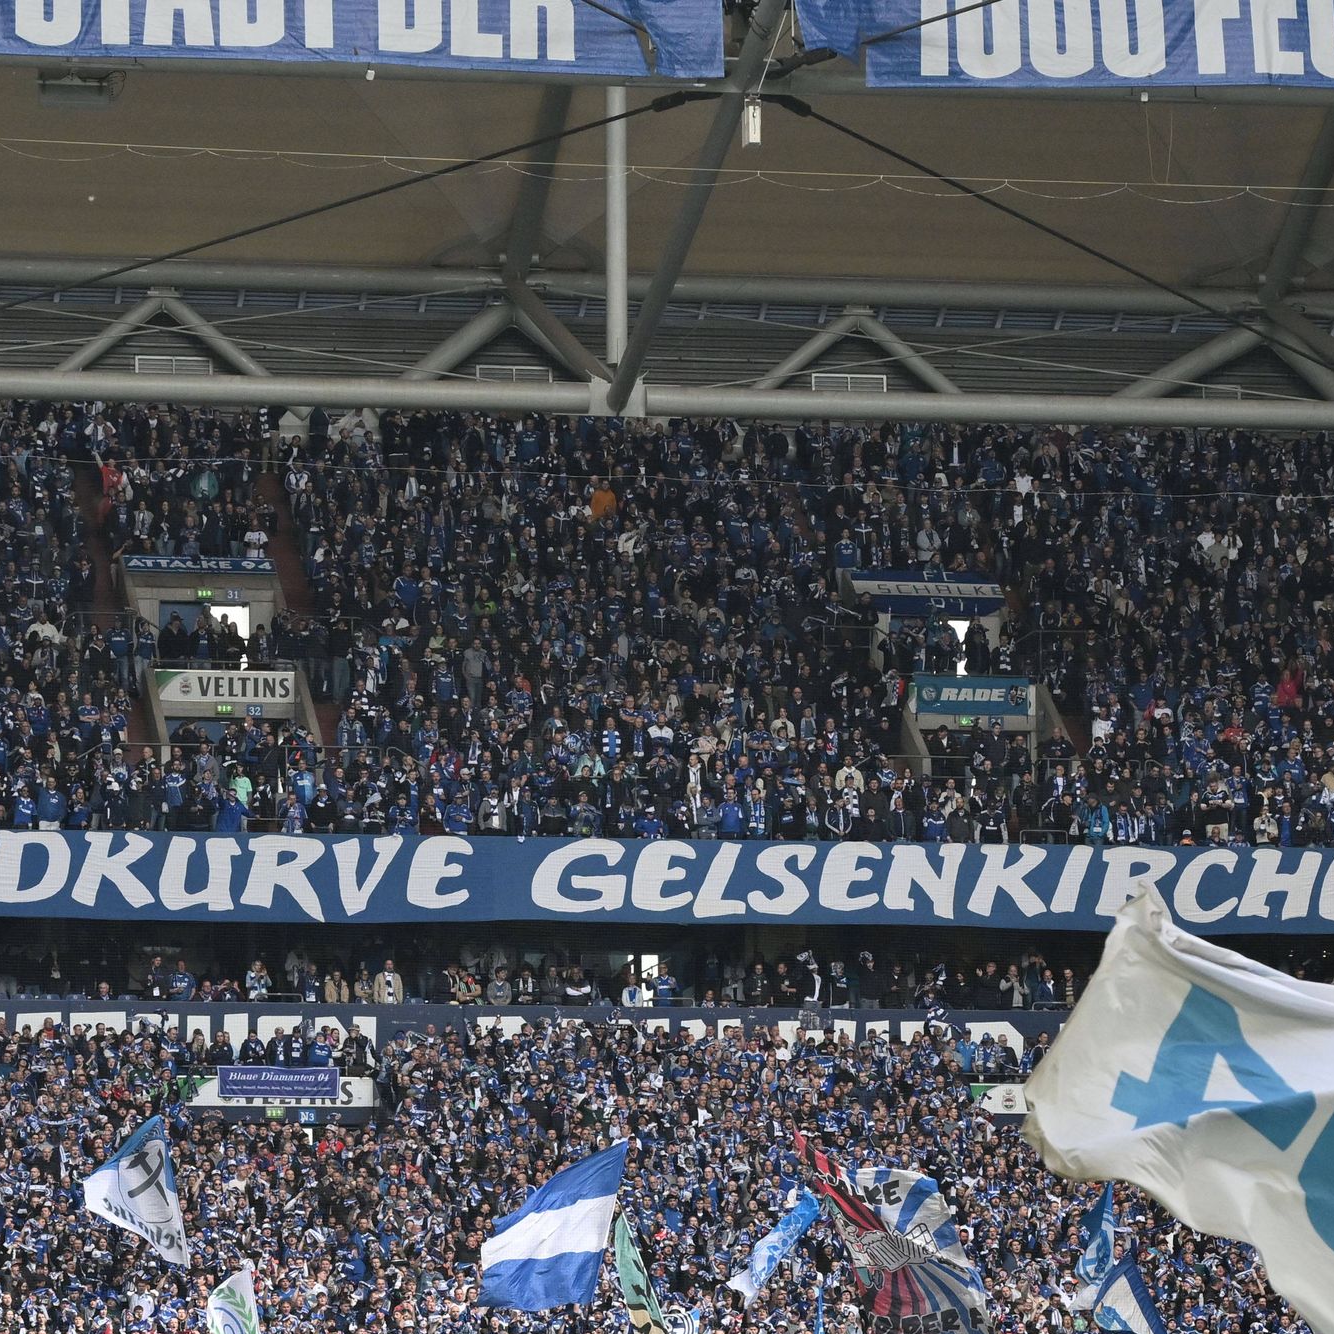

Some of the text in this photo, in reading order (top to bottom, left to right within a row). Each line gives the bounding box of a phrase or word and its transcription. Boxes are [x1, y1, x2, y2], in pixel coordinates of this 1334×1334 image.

[241, 560, 273, 571] 94
[197, 676, 291, 699] VELTINS
[939, 687, 1006, 702] RADE
[249, 706, 262, 717] 32
[228, 1071, 330, 1082] Blaue Diamanten 04
